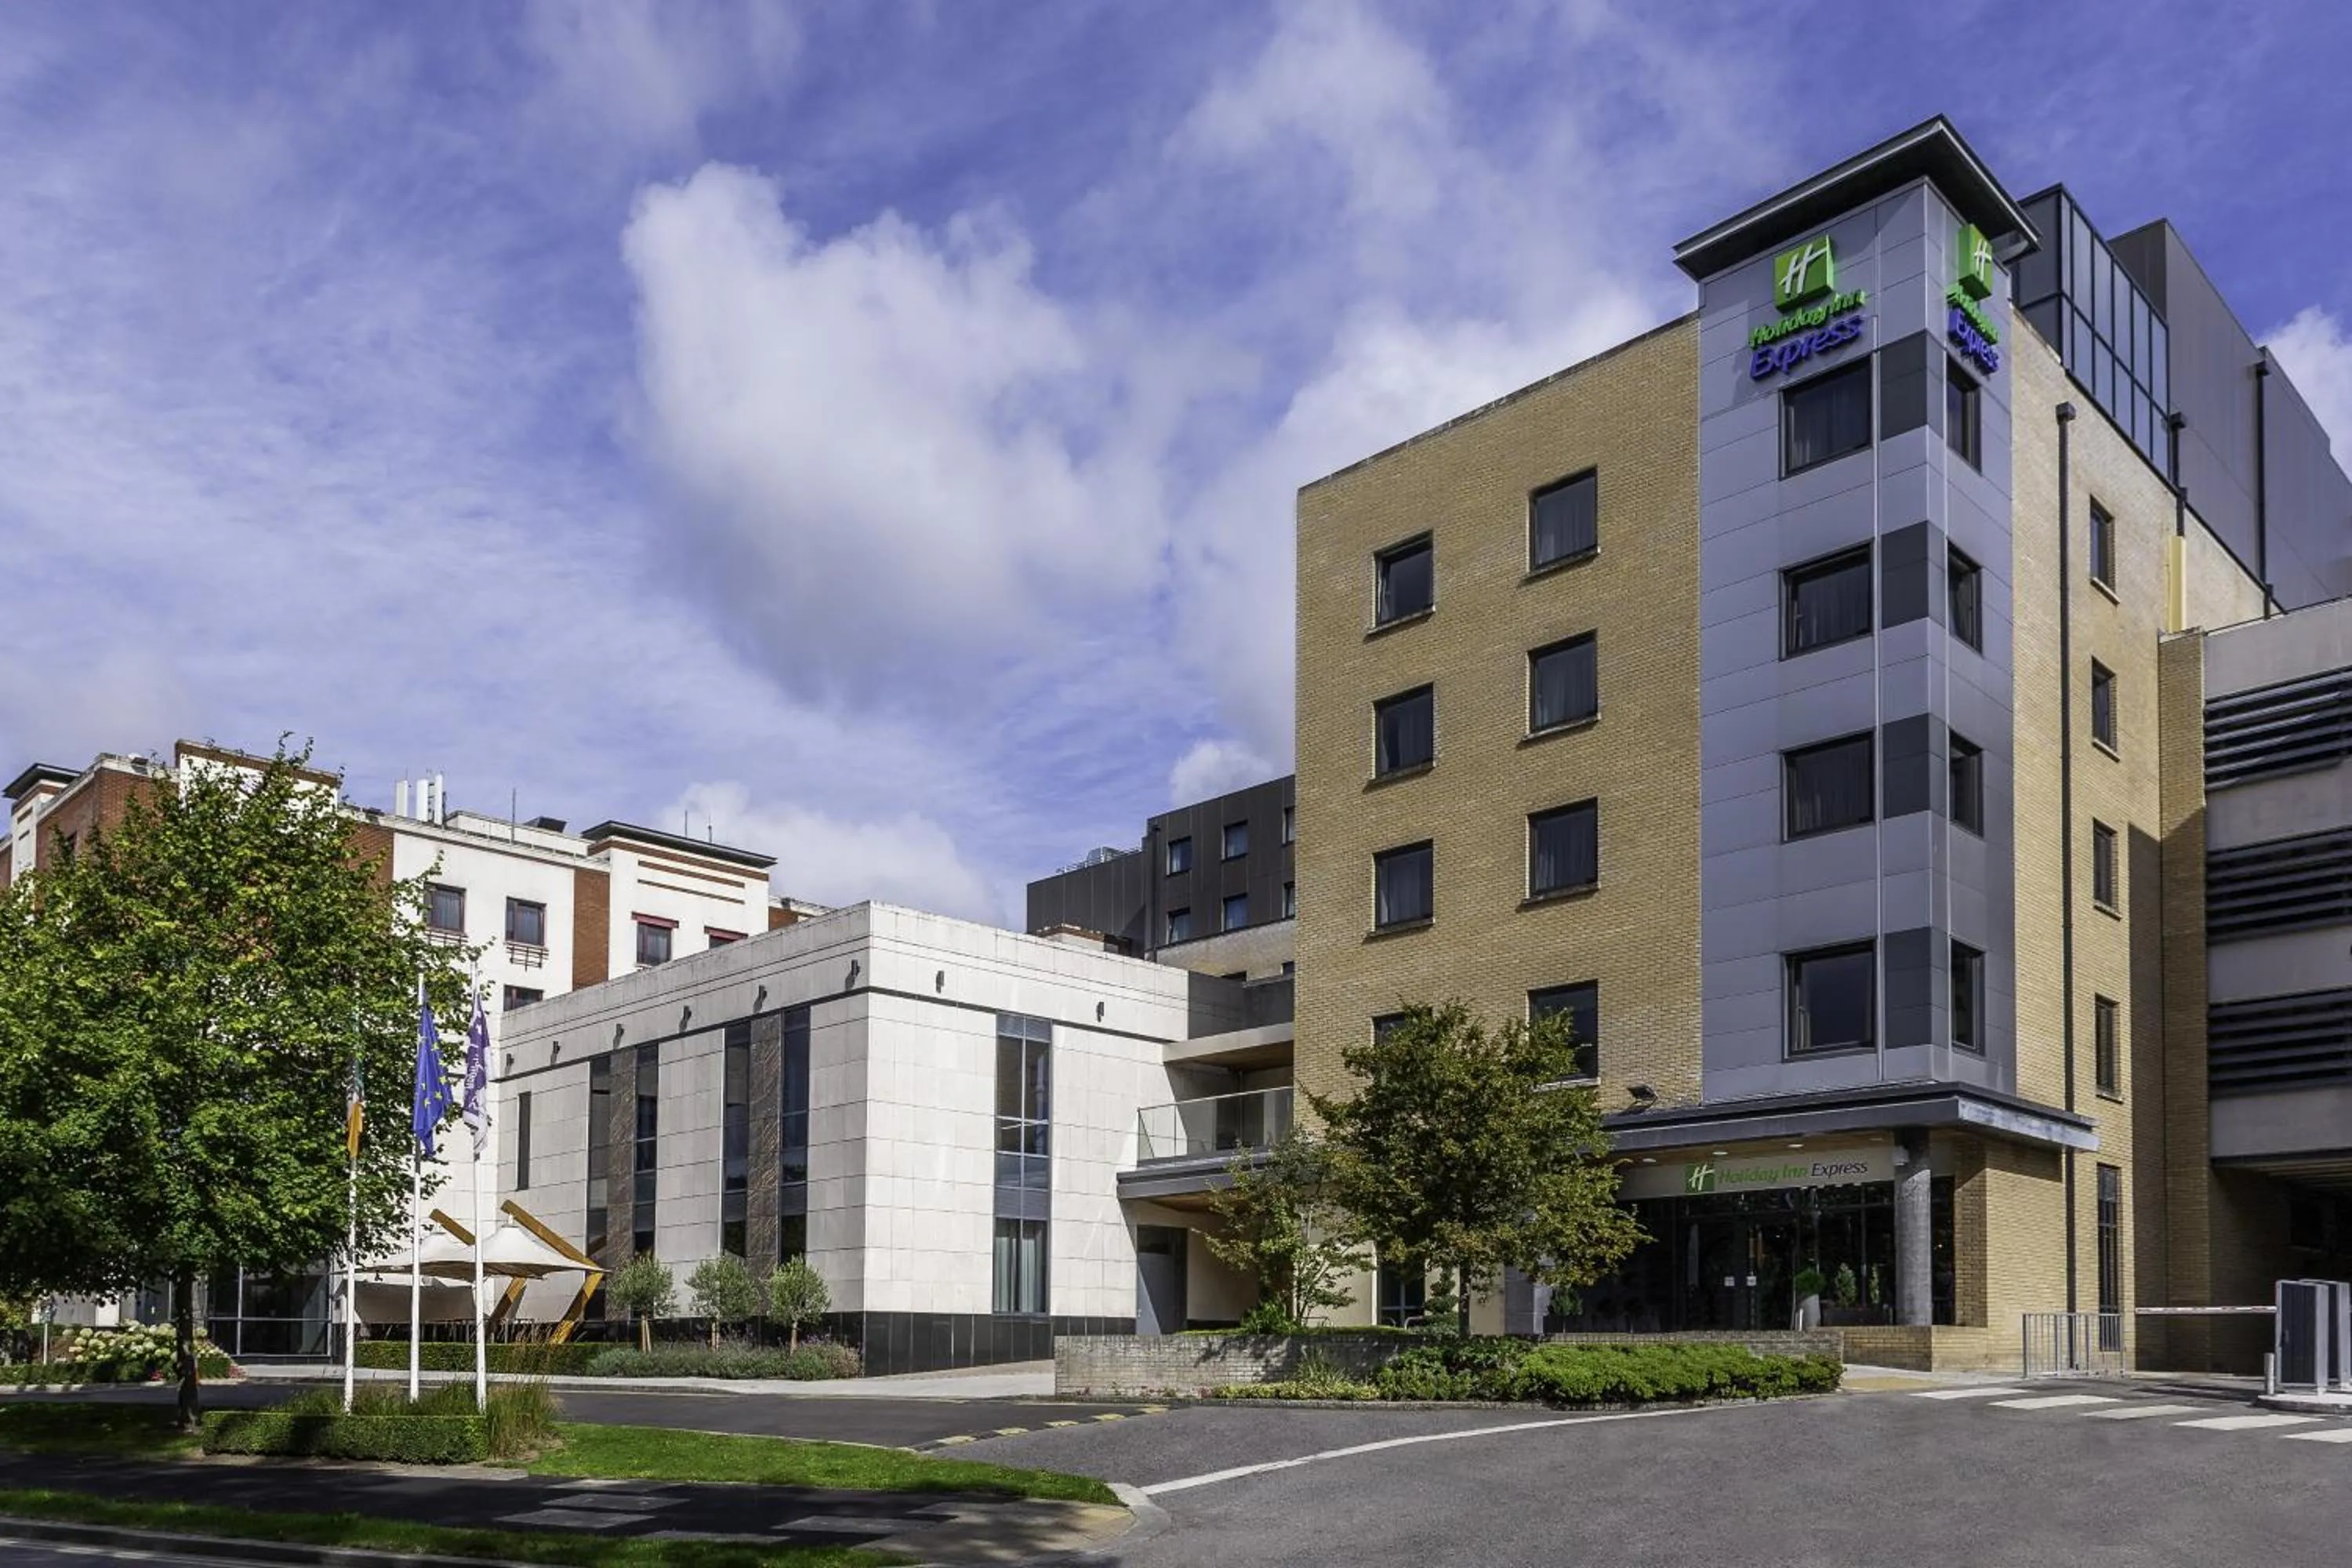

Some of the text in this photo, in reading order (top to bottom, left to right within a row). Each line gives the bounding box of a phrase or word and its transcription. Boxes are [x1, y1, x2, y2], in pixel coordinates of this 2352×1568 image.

[1750, 315, 1865, 379] Express
[1719, 1162, 1869, 1184] Holiday Inn Express
